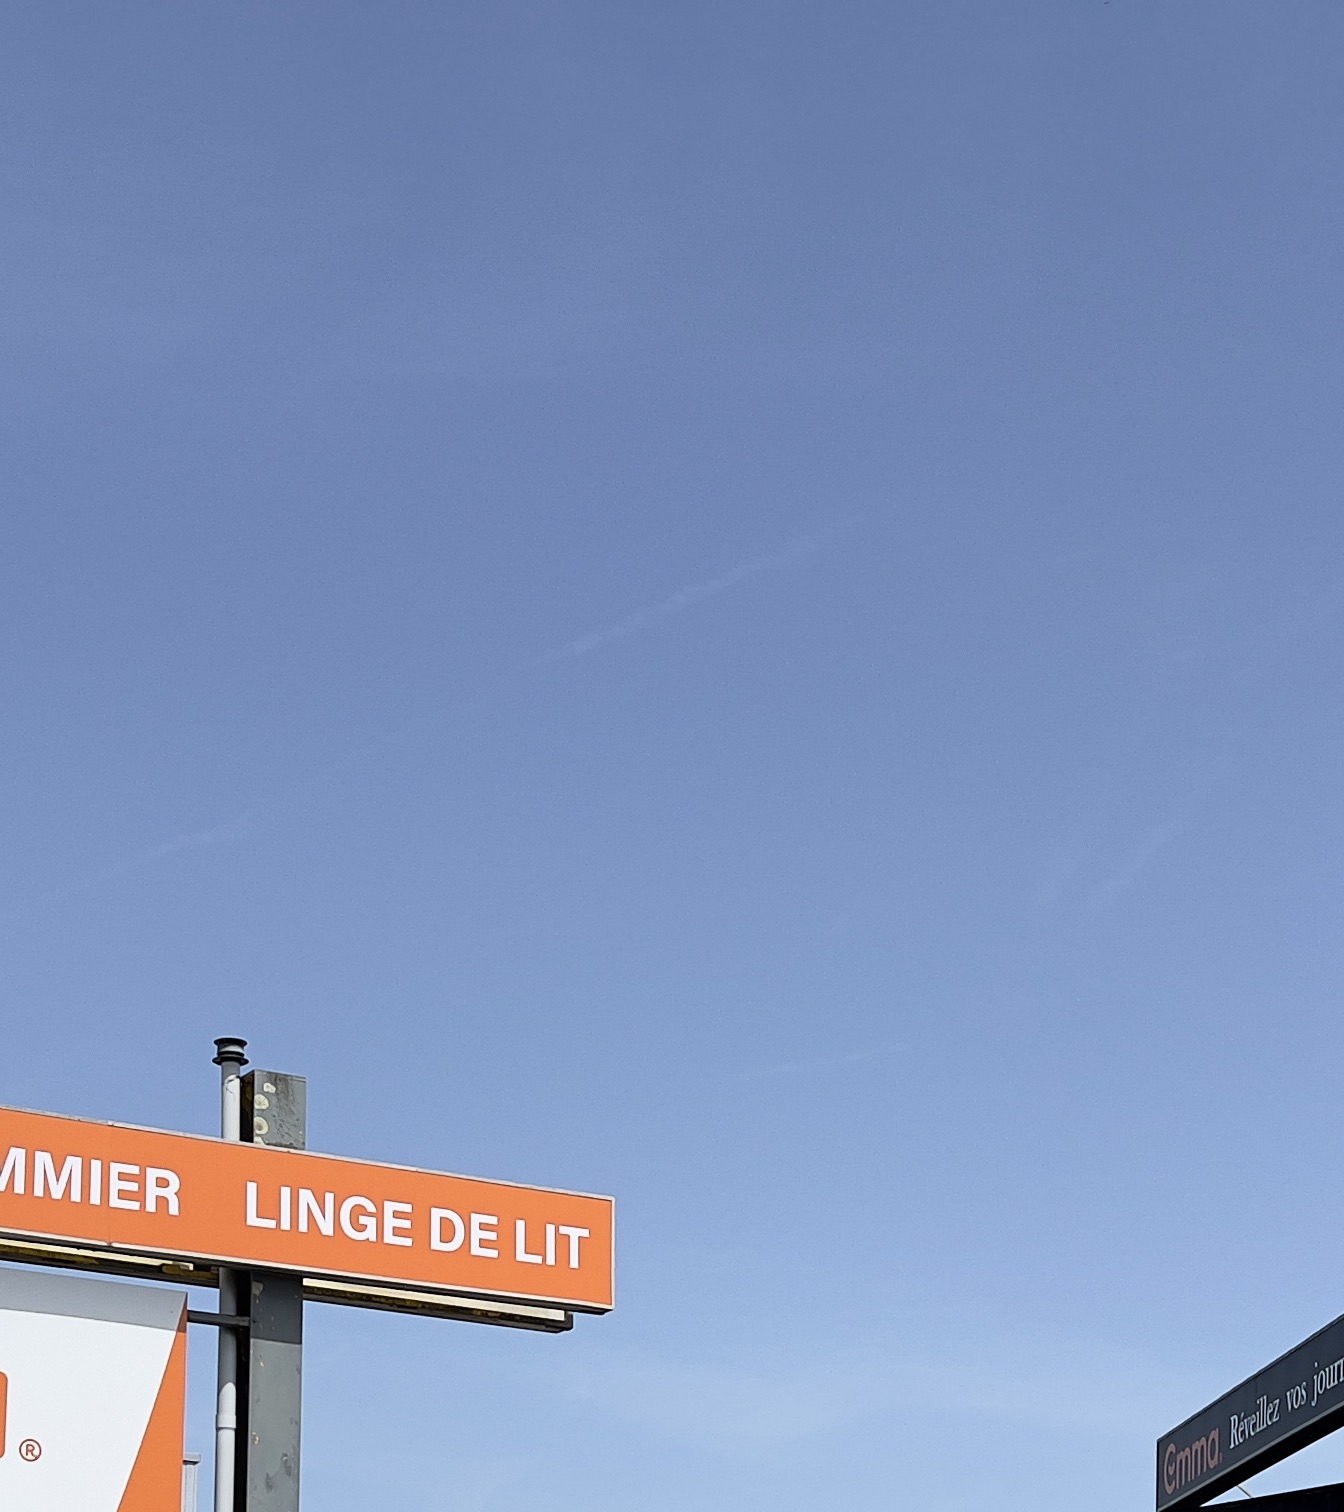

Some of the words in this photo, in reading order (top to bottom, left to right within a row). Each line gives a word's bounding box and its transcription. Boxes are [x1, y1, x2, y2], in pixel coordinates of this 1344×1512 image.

[245, 1181, 414, 1247] LINGE
[429, 1206, 500, 1259] DE
[514, 1219, 590, 1269] LIT
[1229, 1395, 1280, 1449] Réveillez
[1286, 1382, 1307, 1412] vos
